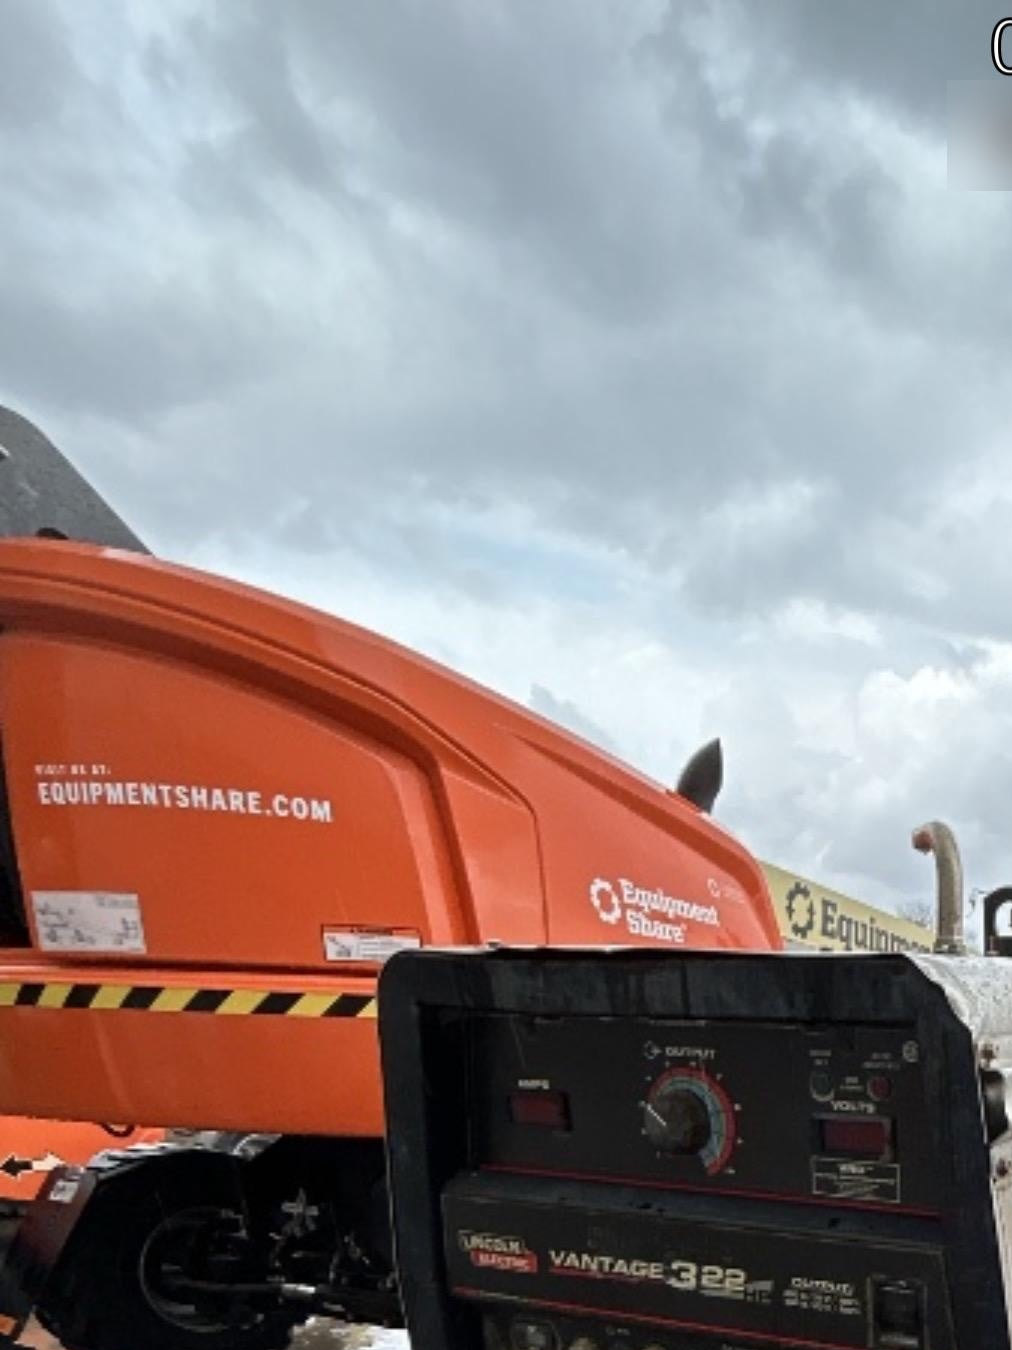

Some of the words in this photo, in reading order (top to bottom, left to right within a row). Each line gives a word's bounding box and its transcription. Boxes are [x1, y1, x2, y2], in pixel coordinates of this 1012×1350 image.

[38, 781, 333, 823] EQUIPMENTSHARE.COM
[619, 878, 720, 927] Equipment
[626, 909, 685, 943] Share
[548, 1250, 665, 1279] VANTAGE
[669, 1259, 747, 1291] 322
